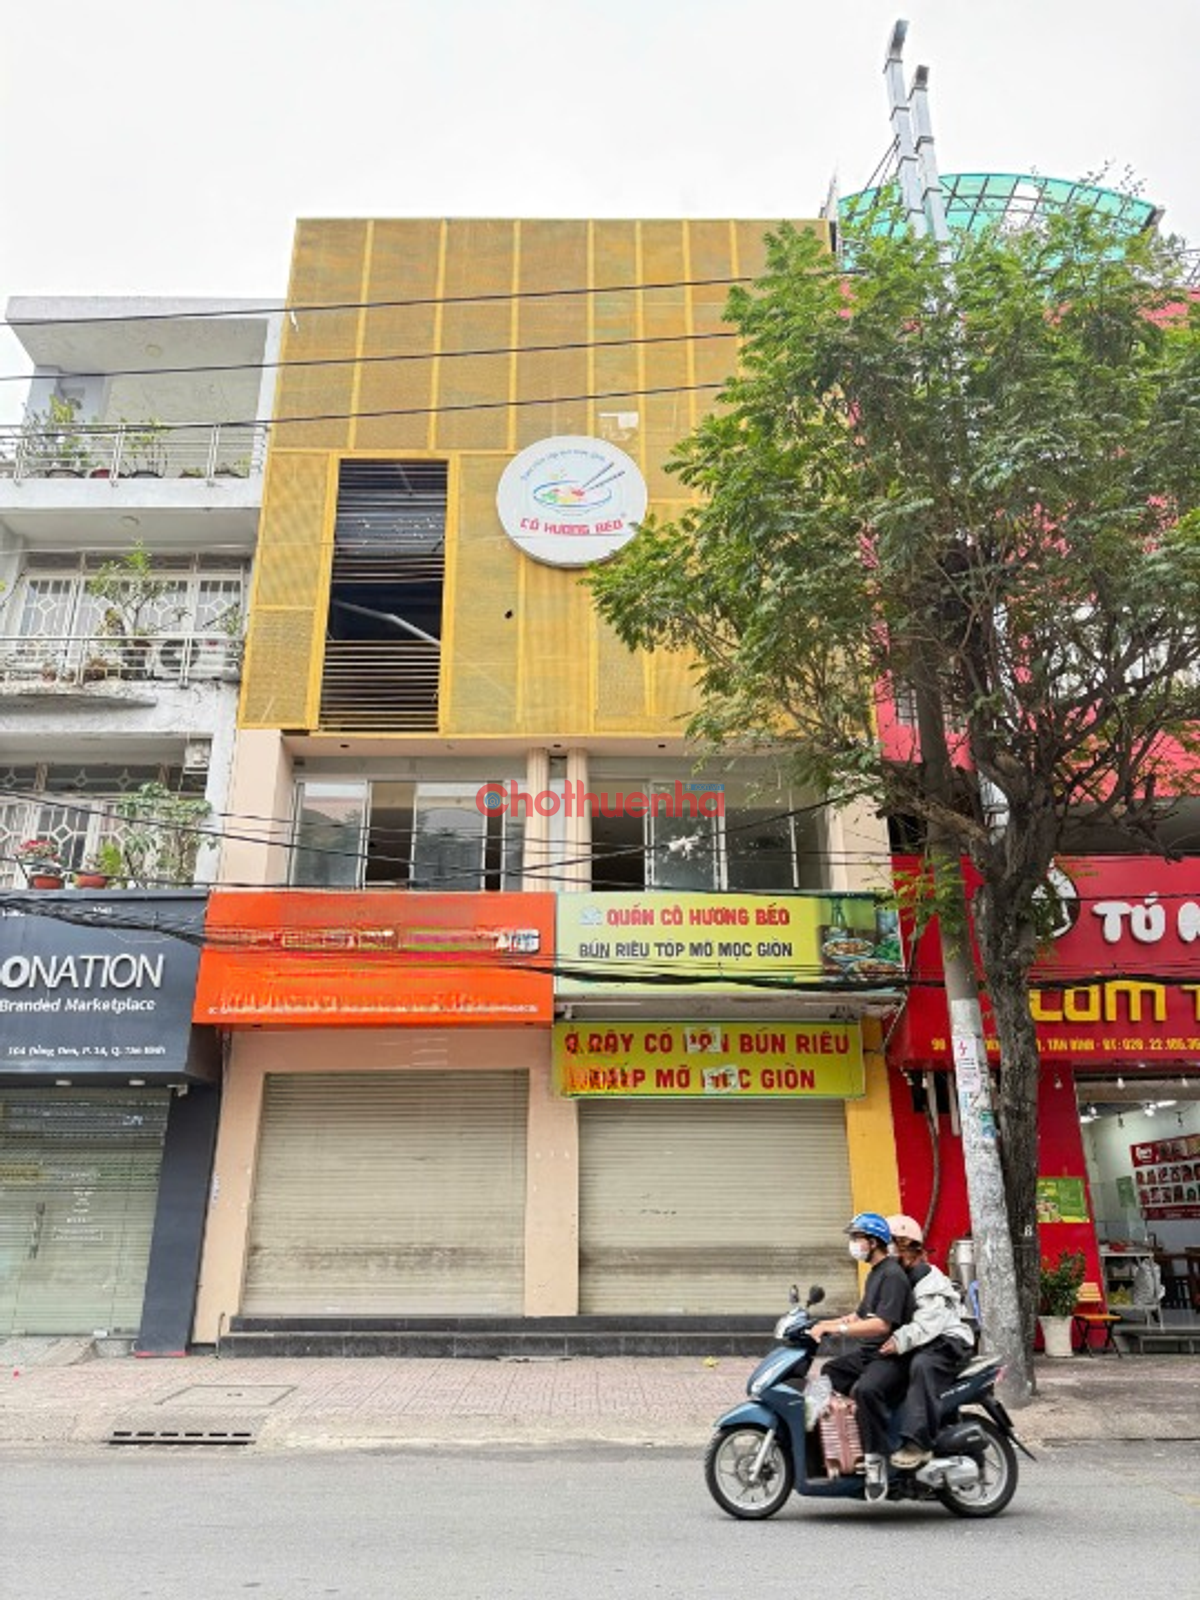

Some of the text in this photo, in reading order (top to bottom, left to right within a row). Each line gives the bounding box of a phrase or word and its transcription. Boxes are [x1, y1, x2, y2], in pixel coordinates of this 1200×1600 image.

[607, 902, 790, 927] QUÁN CÔ HƯƠNG BÉO
[579, 938, 610, 959] BÚN
[615, 940, 650, 958] RIÊU
[0, 997, 157, 1015] Branded Marketplace
[644, 1026, 673, 1053] CÓ
[740, 1026, 786, 1053] BÚN
[796, 1030, 850, 1054] RIÊU
[760, 1061, 816, 1089] GIÒN
